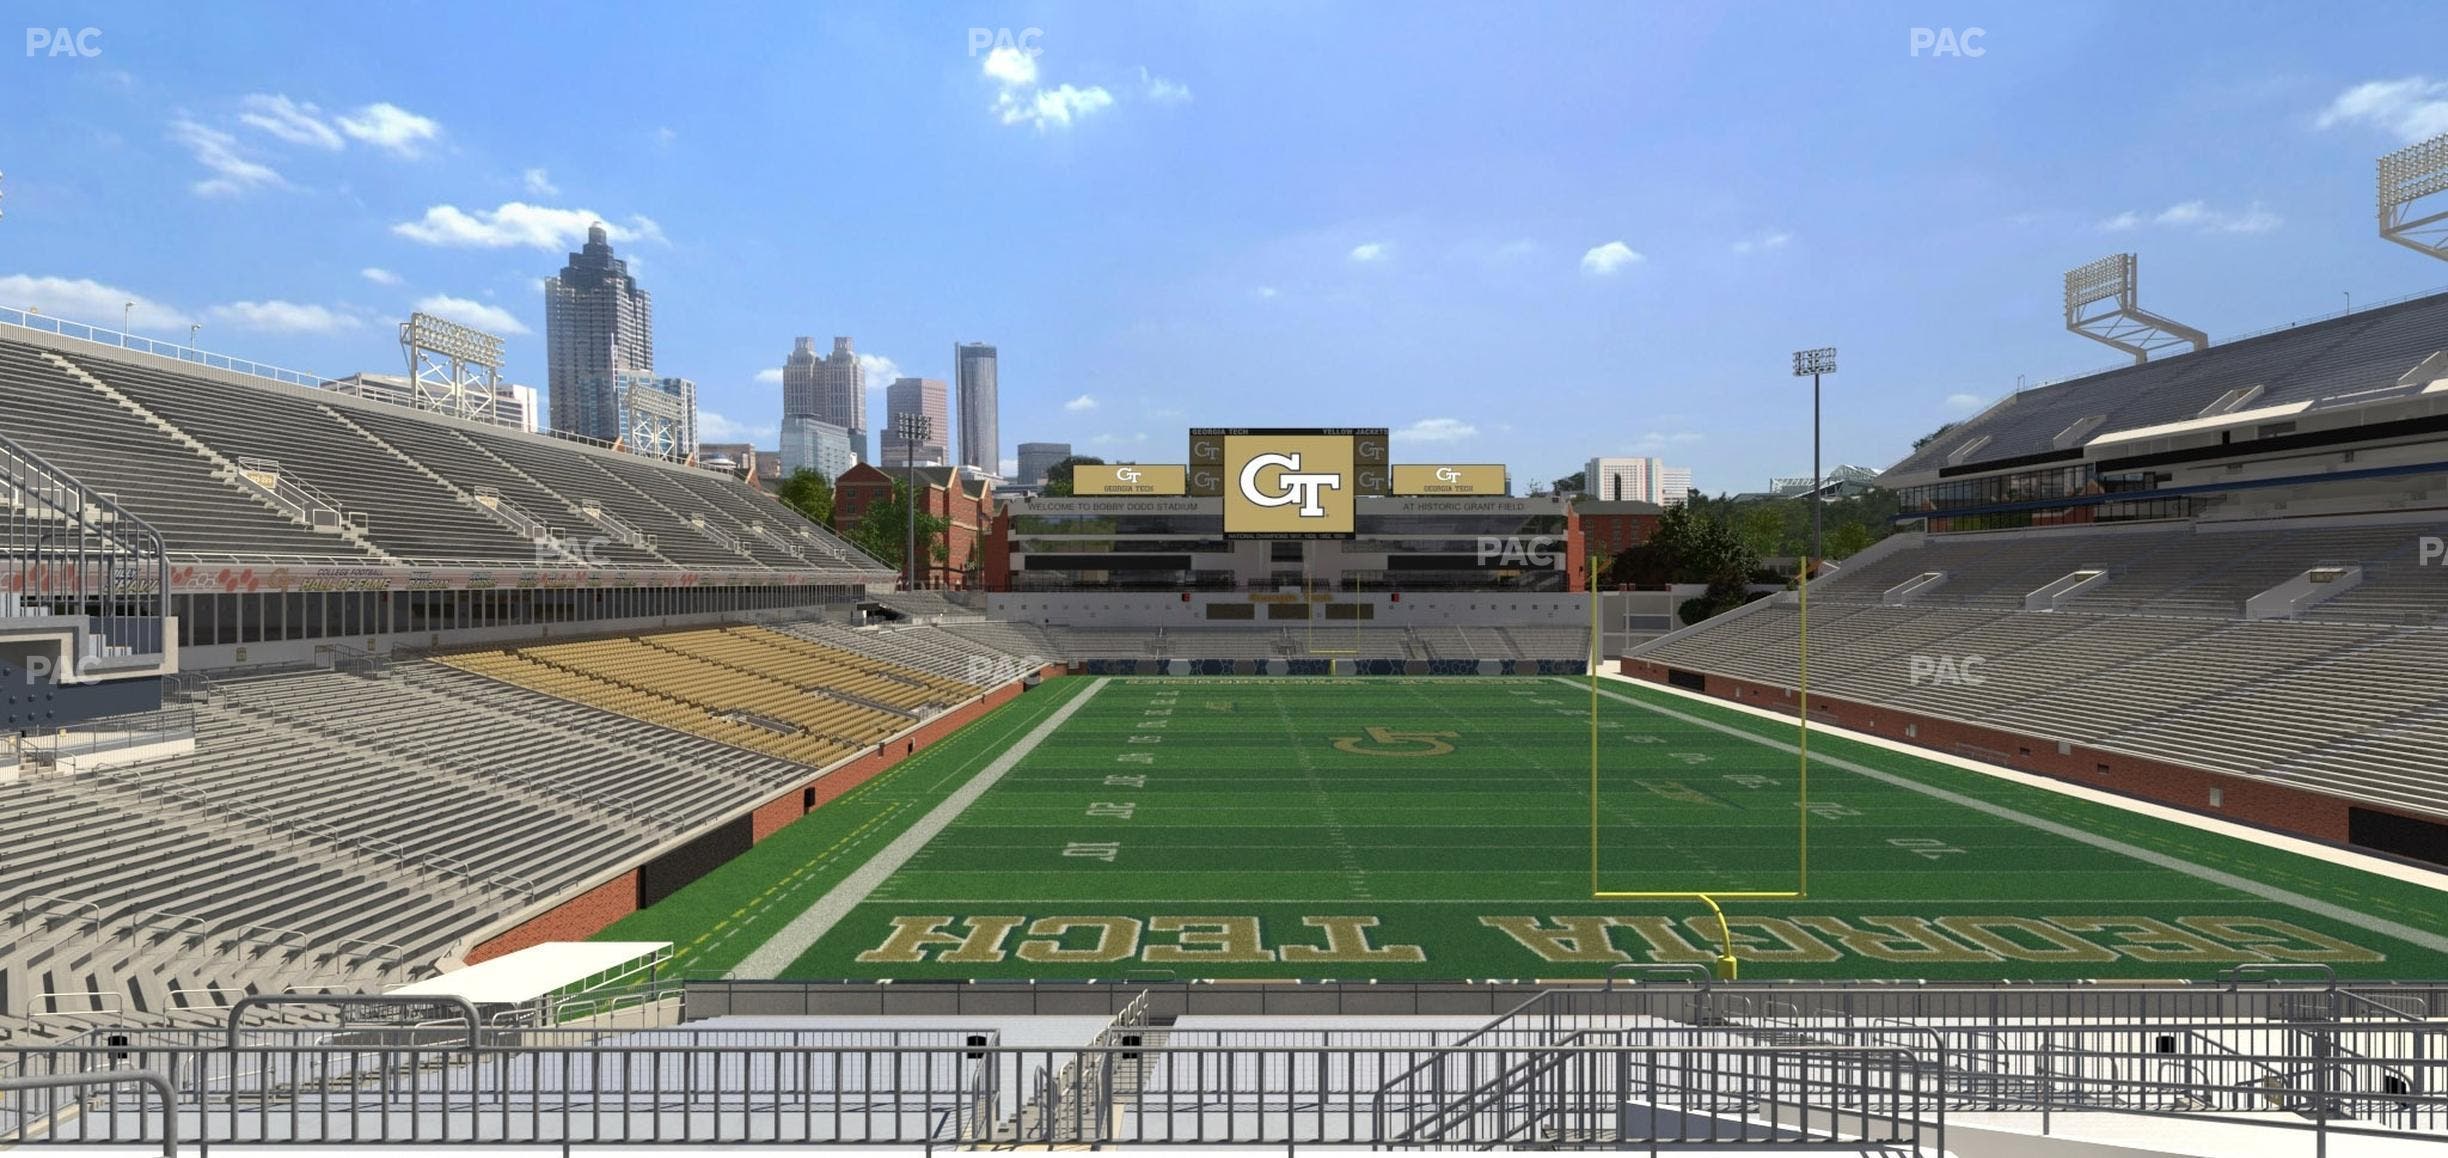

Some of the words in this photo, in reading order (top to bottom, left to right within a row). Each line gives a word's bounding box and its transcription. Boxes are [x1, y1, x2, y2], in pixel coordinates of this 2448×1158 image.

[1116, 467, 1141, 483] GT
[1436, 467, 1461, 483] GT
[1239, 452, 1341, 517] GT
[1028, 503, 1075, 511] WELCOME
[1078, 503, 1091, 511] TO
[1093, 503, 1123, 511] BOBBY
[1157, 503, 1198, 511] STADIUM
[1418, 503, 1462, 511] HISTORIC
[1464, 503, 1494, 511] GRANT
[1498, 503, 1524, 511] FIELD
[302, 577, 336, 590] HALL
[337, 577, 355, 590] OF
[356, 577, 392, 590] FAME
[855, 915, 1428, 963] TECH
[1478, 915, 2386, 963] GEORGIA
